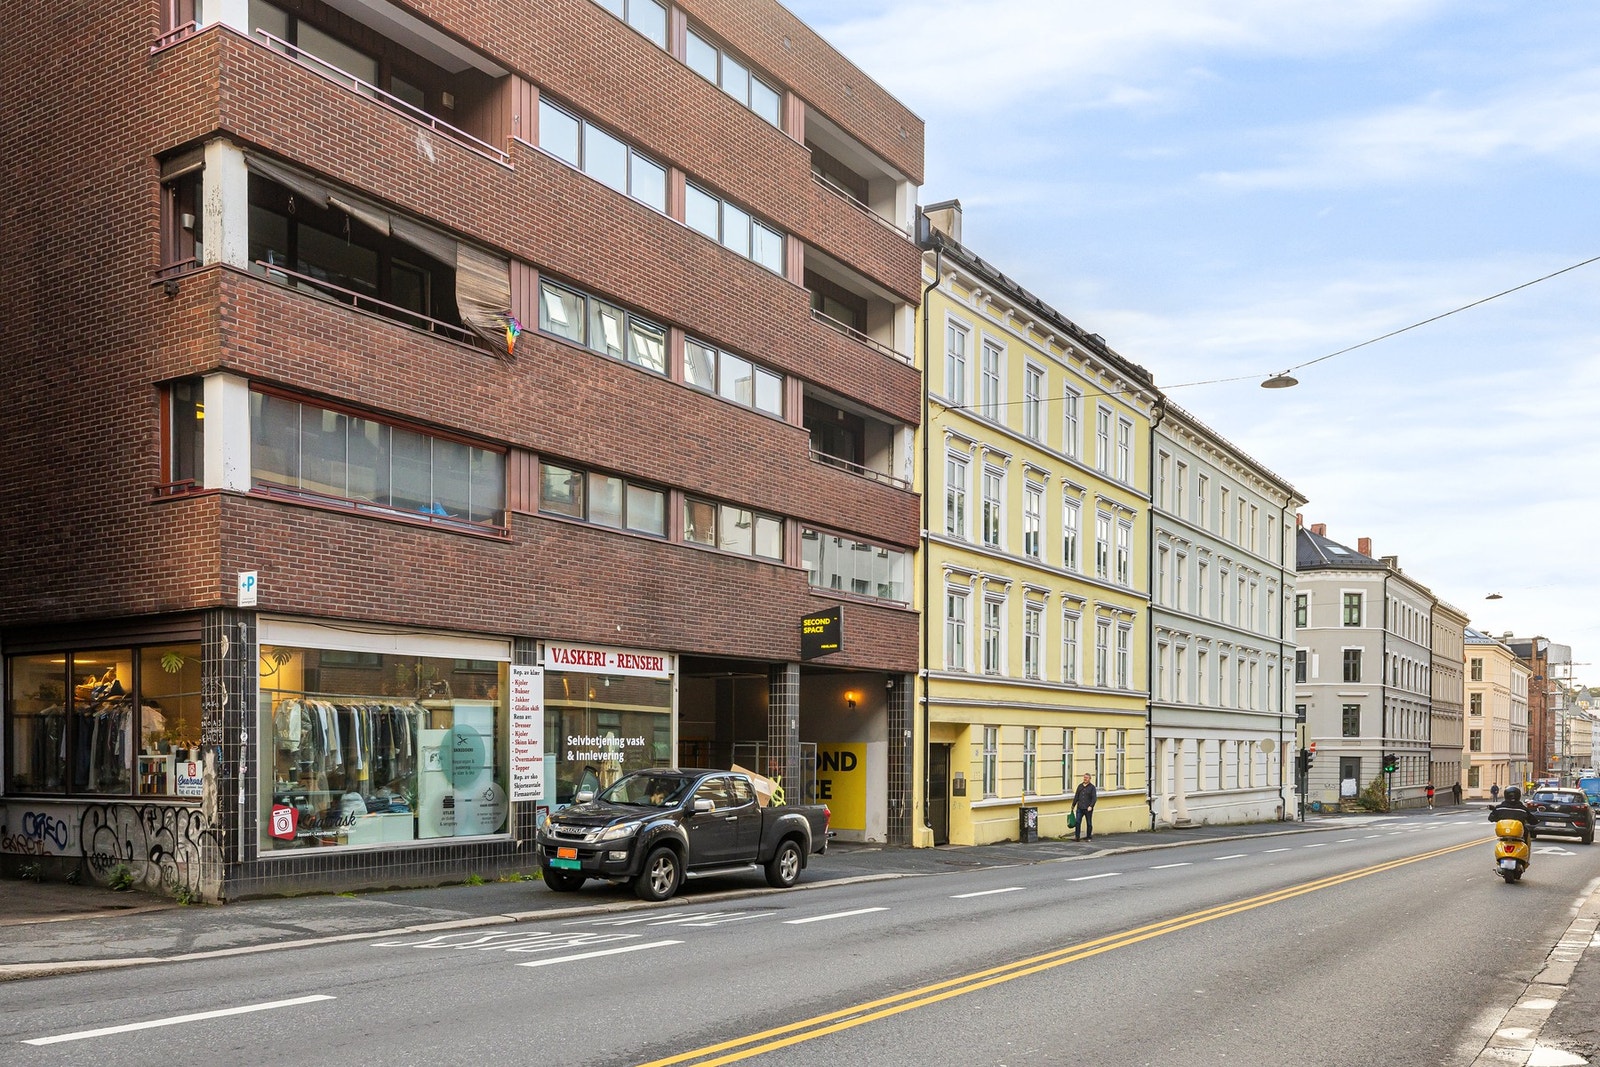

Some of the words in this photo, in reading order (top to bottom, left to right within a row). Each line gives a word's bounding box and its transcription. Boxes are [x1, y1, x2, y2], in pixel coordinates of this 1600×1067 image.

[247, 576, 254, 592] P
[803, 618, 830, 626] SECOND
[552, 648, 606, 667] VASKERI
[617, 653, 664, 671] RENSERI
[567, 735, 625, 748] Selvbetjening
[626, 736, 645, 746] vask
[567, 750, 574, 760] &
[576, 750, 624, 762] Innlevering
[370, 931, 642, 952] BUSS
